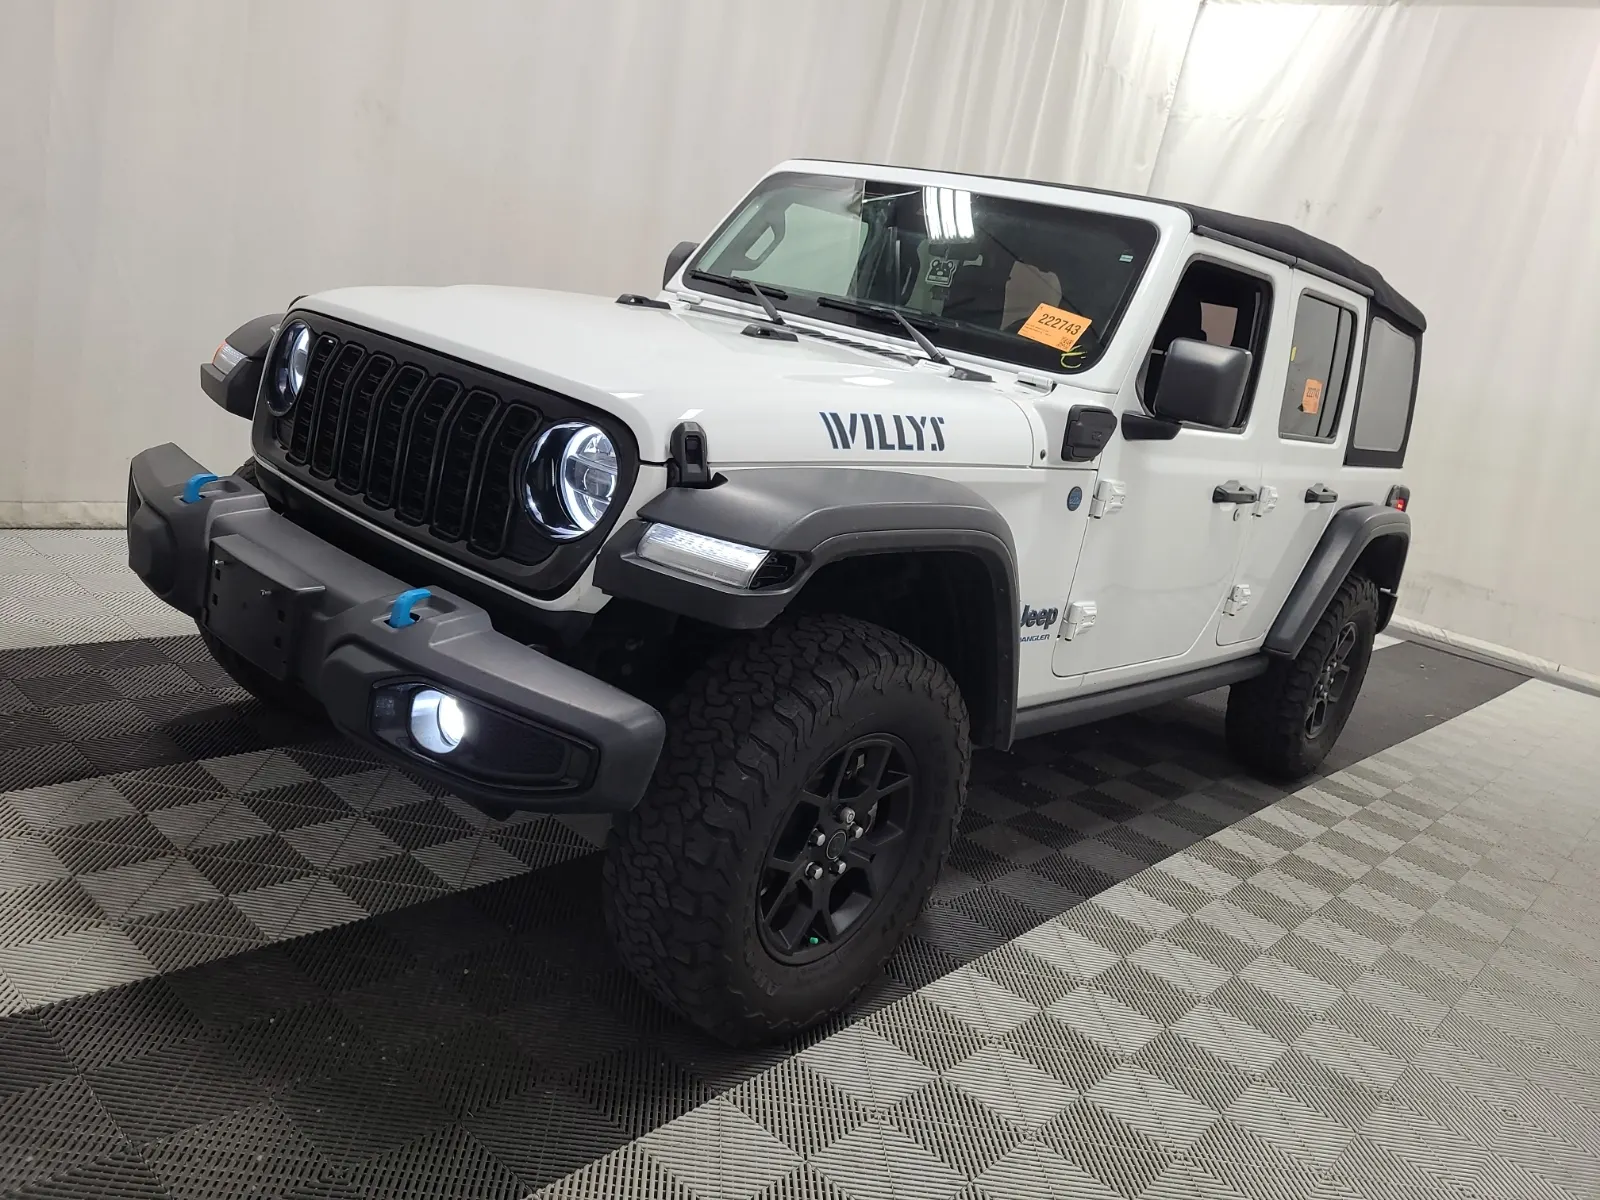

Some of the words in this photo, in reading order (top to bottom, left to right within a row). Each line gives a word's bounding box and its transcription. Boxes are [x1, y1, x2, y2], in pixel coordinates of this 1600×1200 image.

[1038, 313, 1081, 336] 222743
[819, 411, 945, 451] WILLYS
[1020, 604, 1059, 630] Jeep
[1020, 634, 1050, 642] ANGLER
